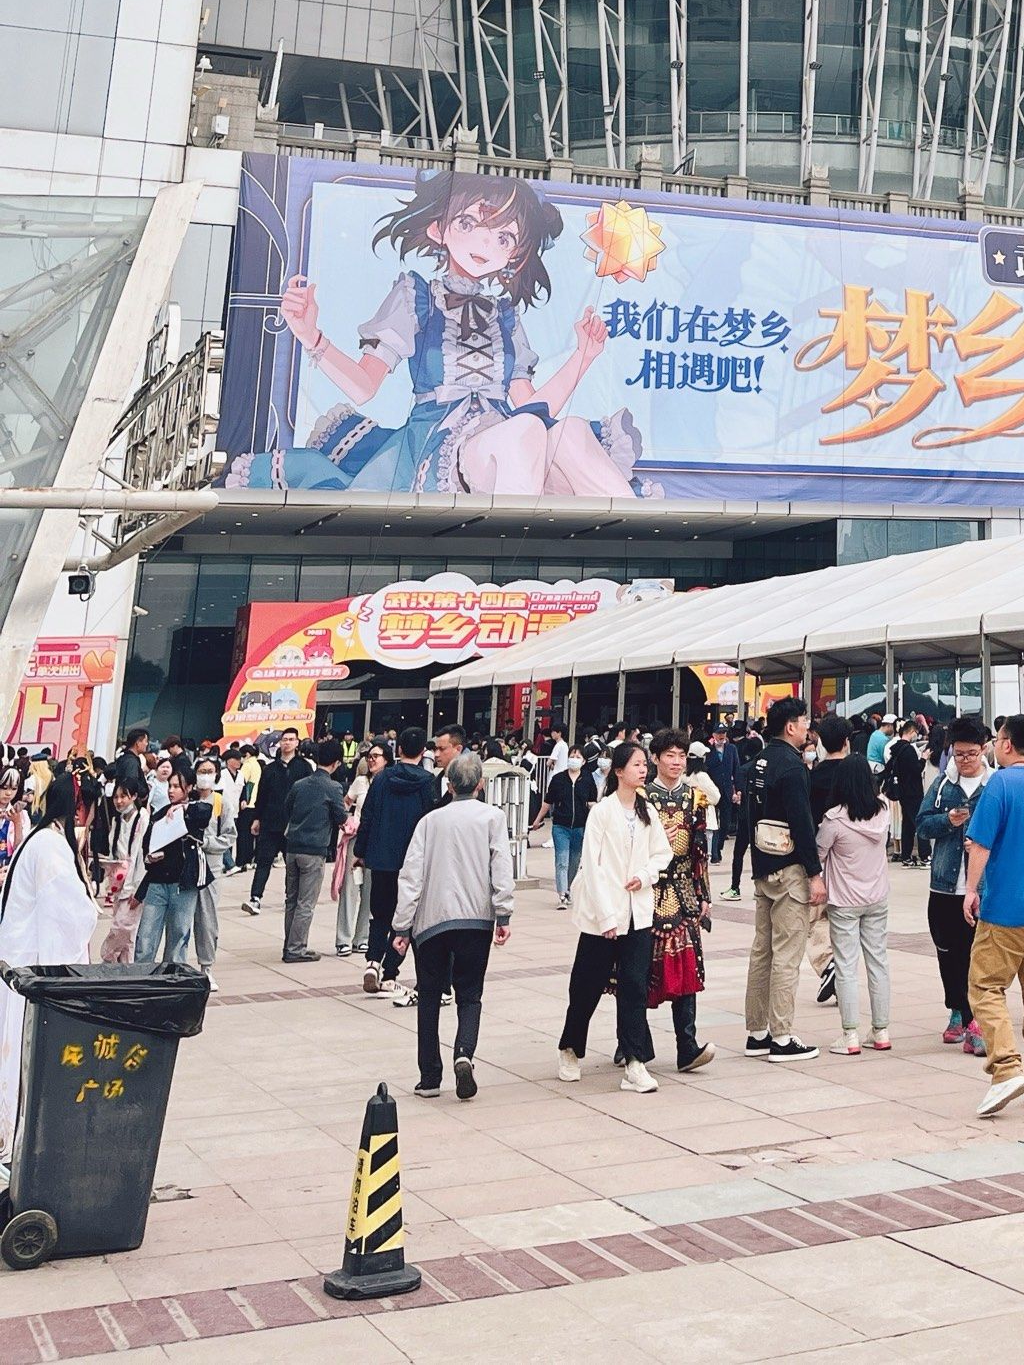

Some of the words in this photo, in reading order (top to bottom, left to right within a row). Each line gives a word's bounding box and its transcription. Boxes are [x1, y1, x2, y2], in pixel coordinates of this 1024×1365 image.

[602, 297, 792, 349] 我们在梦乡
[384, 592, 528, 610] 武汉第十四届
[530, 591, 599, 602] Dreamland
[530, 603, 596, 611] comic-con
